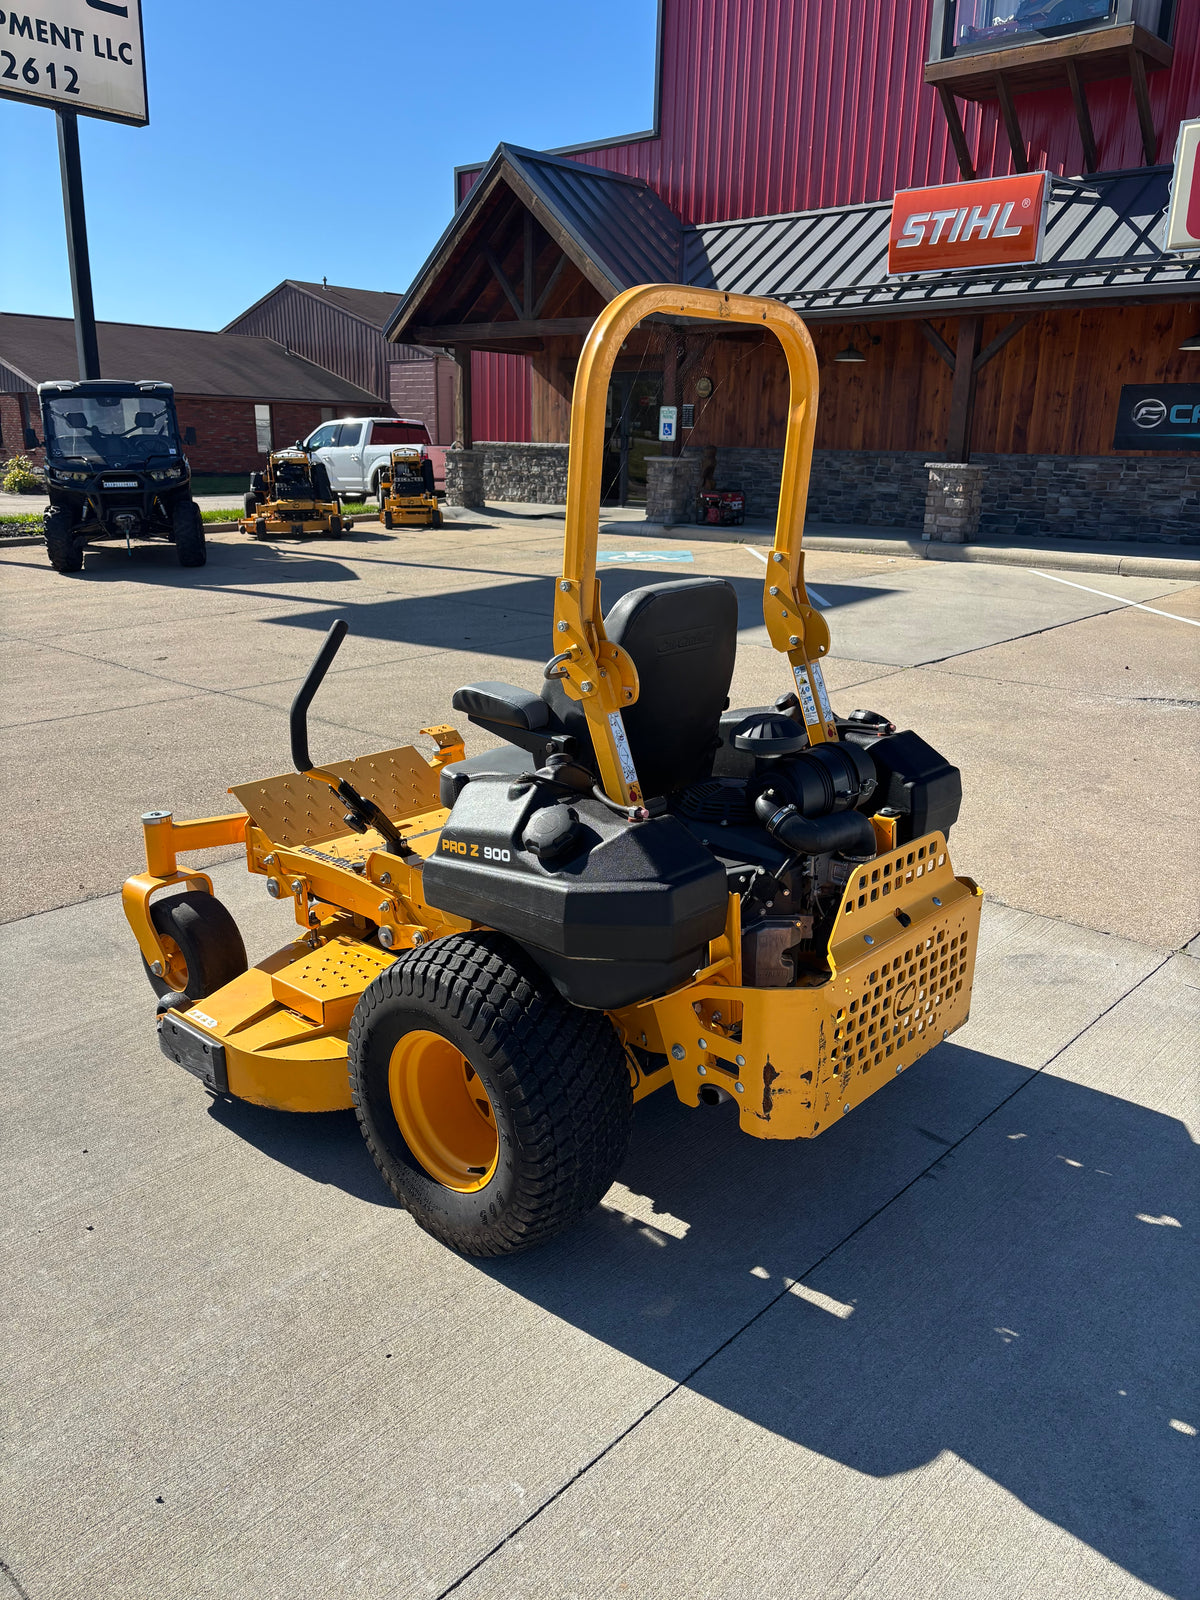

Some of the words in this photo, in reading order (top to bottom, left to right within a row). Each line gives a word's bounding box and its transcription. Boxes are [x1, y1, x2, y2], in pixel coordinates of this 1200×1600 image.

[93, 34, 133, 65] LLC
[0, 50, 80, 94] 2612
[896, 201, 1022, 248] STIHL
[441, 838, 467, 855] PRO
[470, 844, 479, 857] Z
[483, 846, 511, 862] 900
